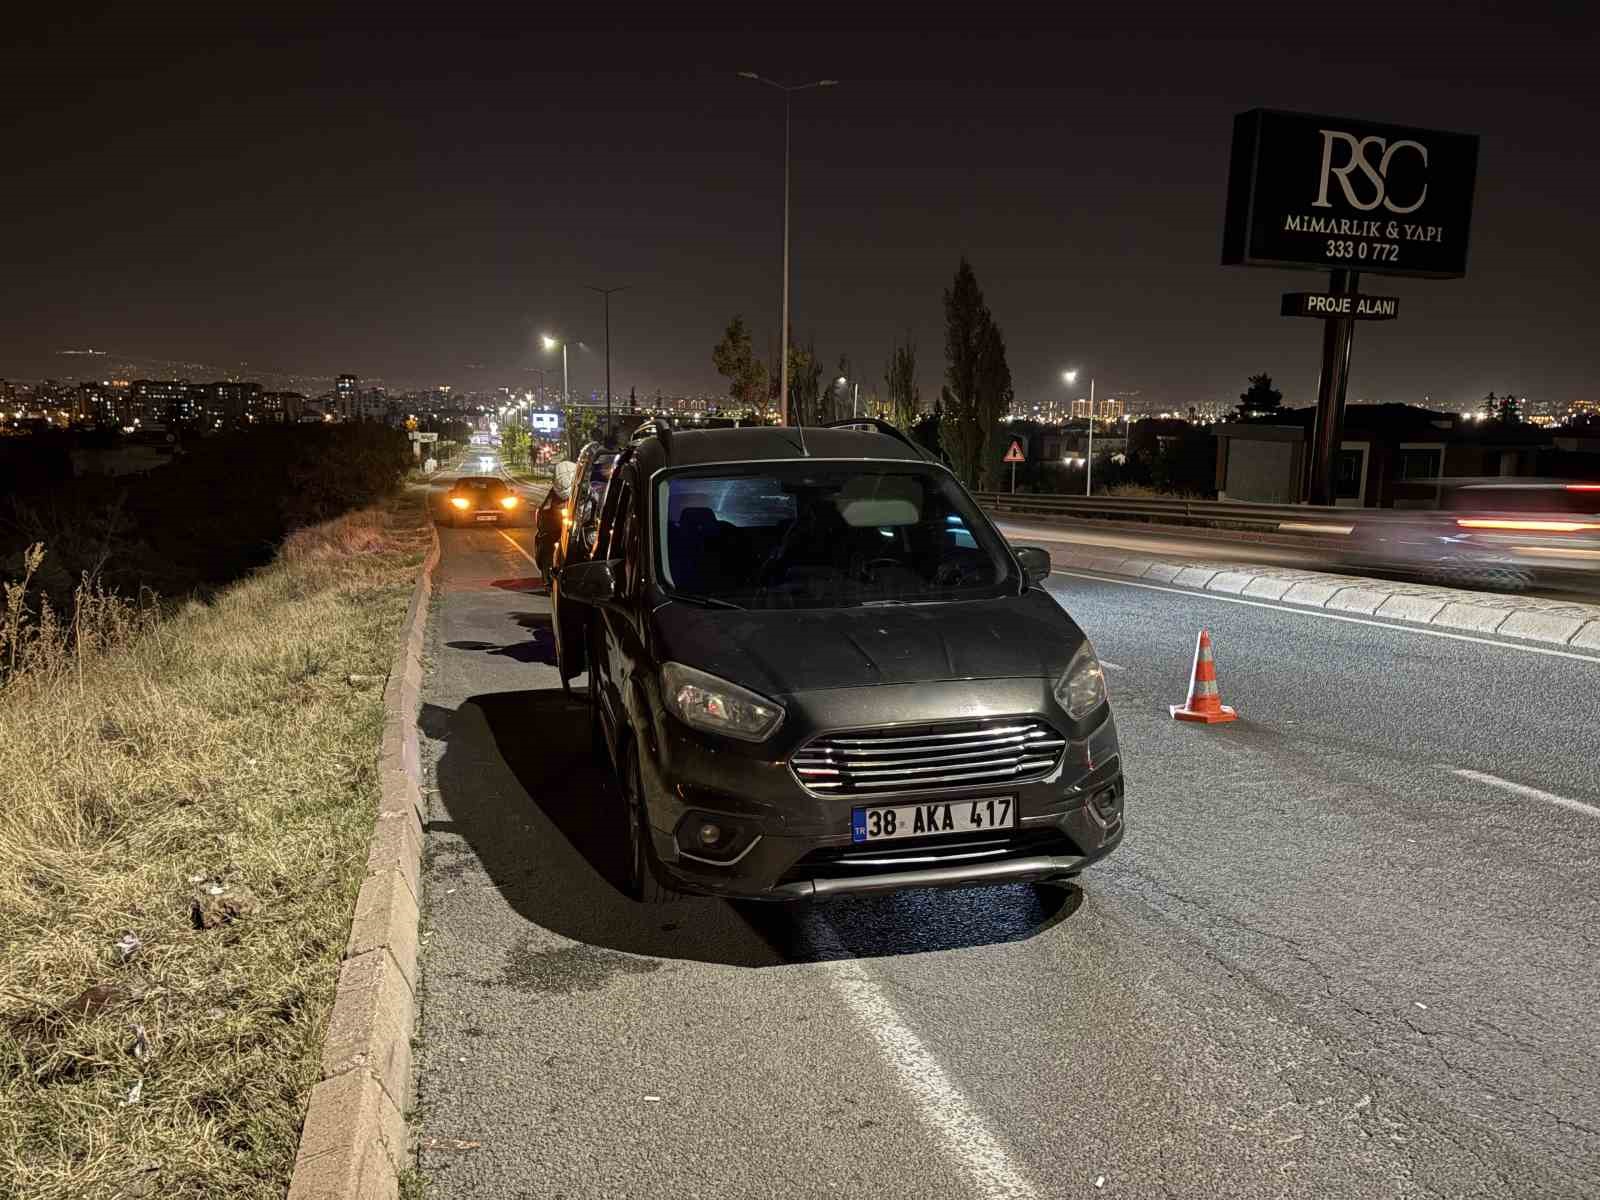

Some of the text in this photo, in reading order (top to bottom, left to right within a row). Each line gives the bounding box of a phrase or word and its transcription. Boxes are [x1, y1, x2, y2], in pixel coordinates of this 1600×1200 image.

[1312, 130, 1428, 213] RSC
[1386, 221, 1400, 240] &
[1405, 224, 1443, 243] YAPI
[1326, 240, 1399, 261] 333 0 772
[1307, 296, 1395, 315] PROJE ALANI
[868, 800, 1011, 836] 38 AKA 417
[855, 827, 866, 835] TR
